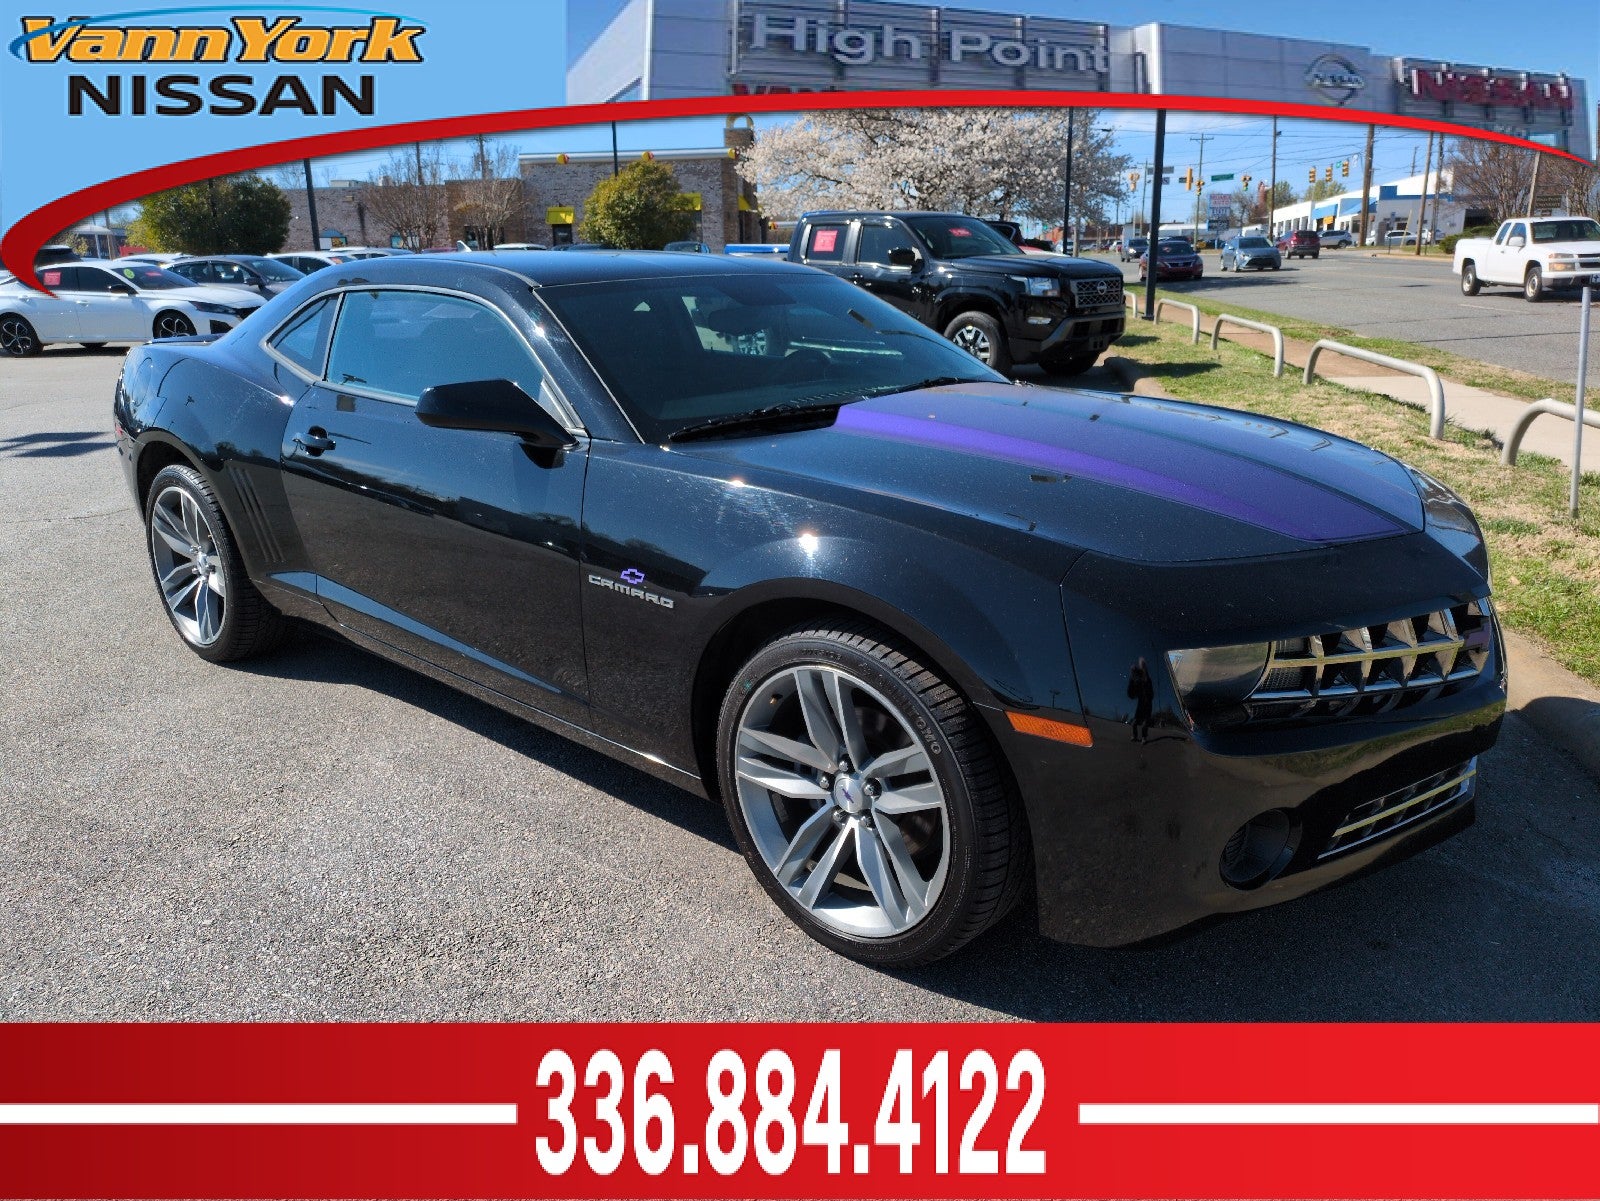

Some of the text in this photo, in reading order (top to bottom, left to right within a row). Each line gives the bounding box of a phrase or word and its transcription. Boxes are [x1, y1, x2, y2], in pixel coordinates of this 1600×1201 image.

[750, 13, 1110, 73] High Point
[588, 574, 675, 609] CAMARO
